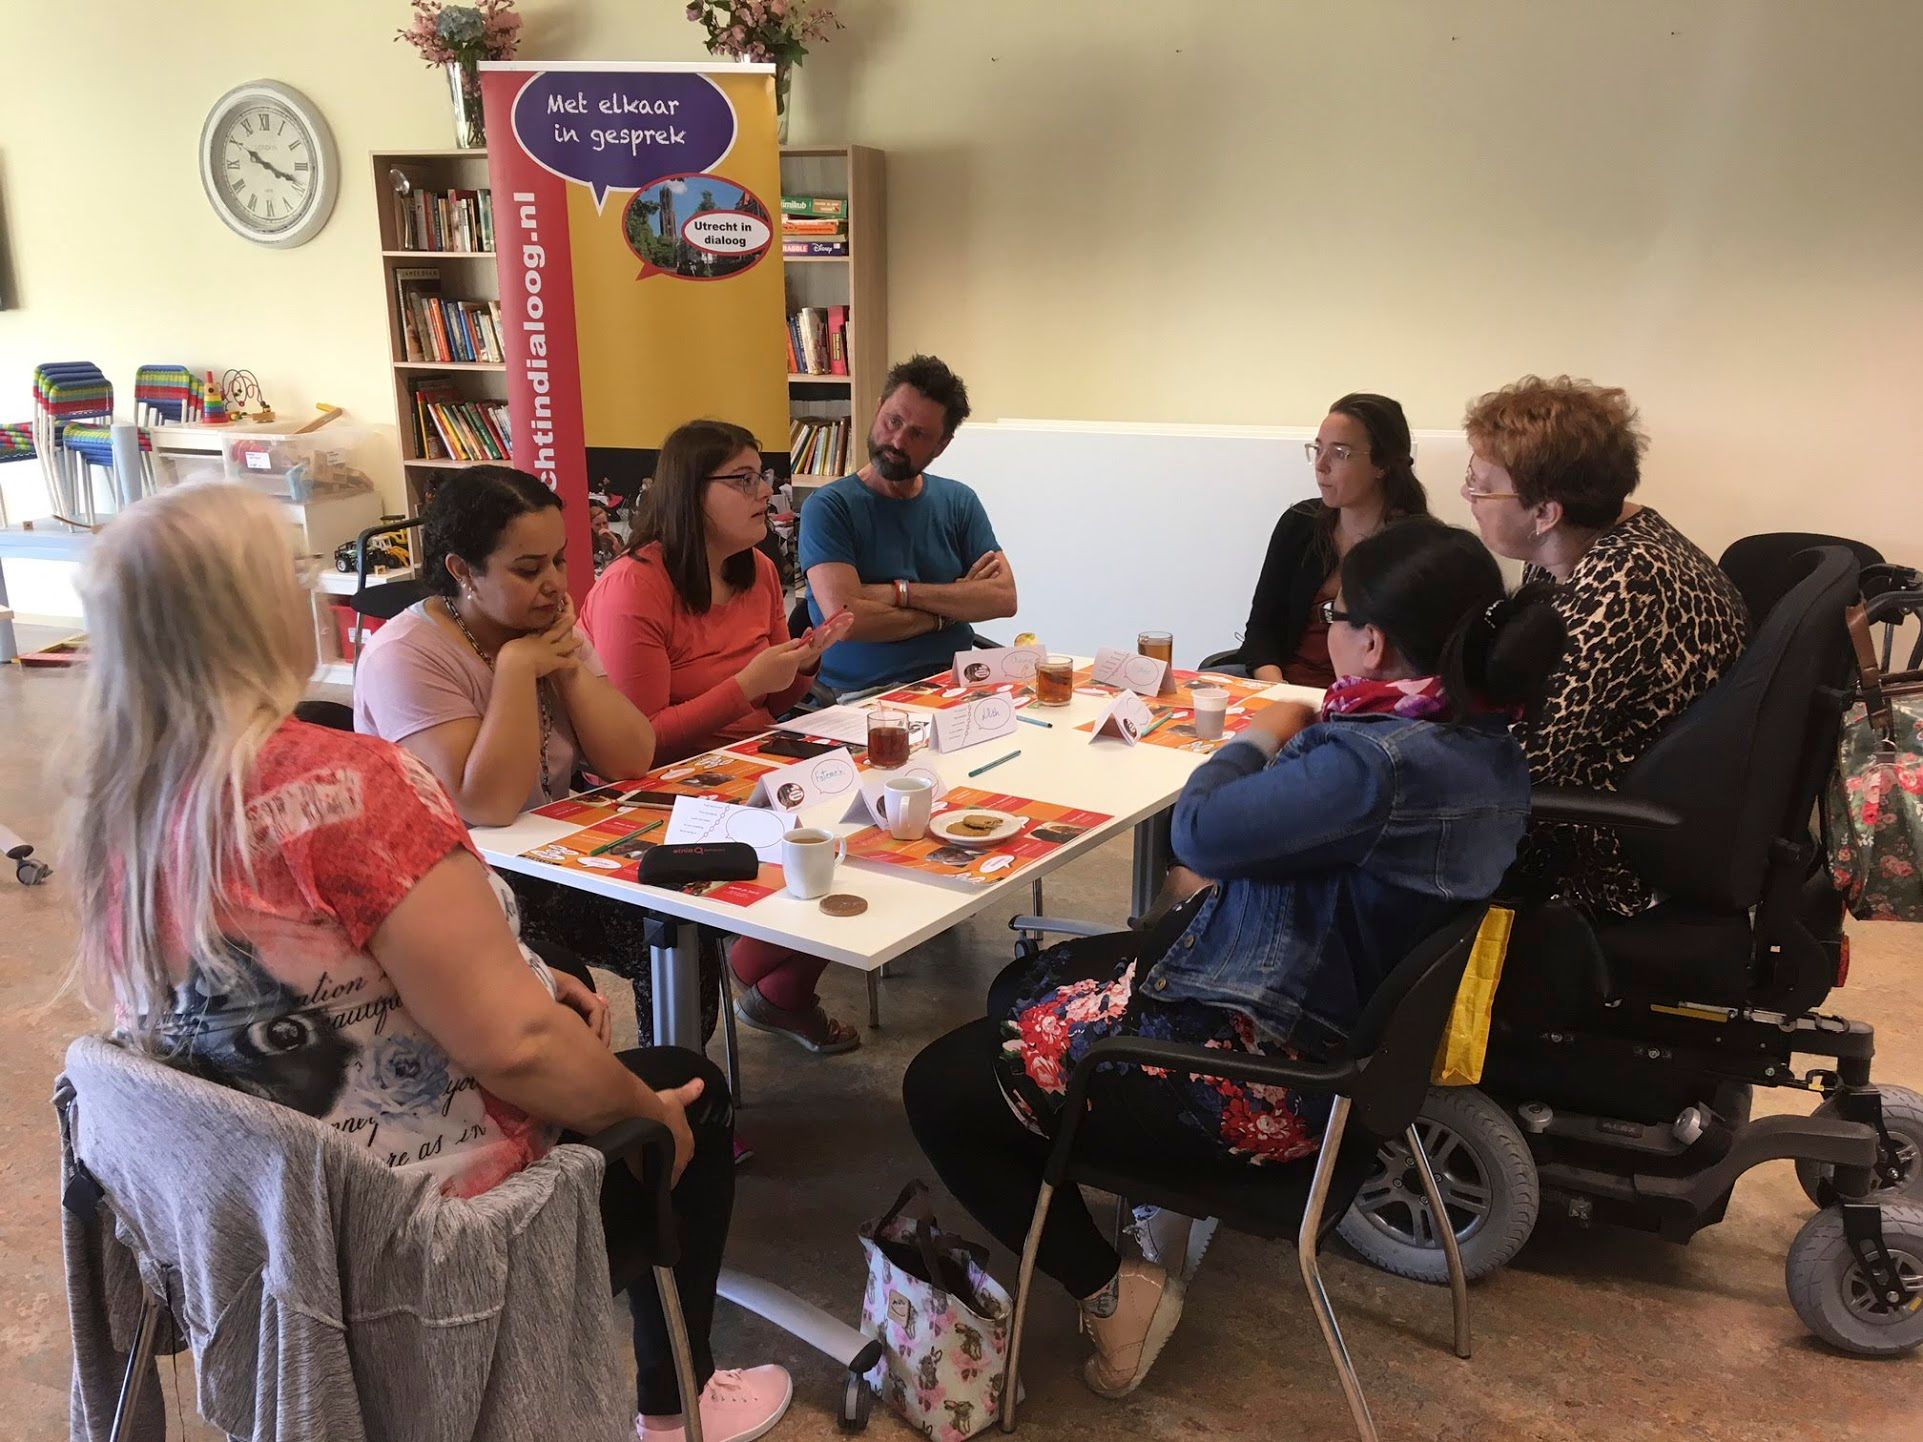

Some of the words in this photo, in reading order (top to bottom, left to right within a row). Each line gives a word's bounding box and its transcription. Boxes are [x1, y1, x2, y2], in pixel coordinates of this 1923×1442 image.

[547, 92, 588, 114] Met
[599, 93, 680, 115] elkaar
[258, 113, 270, 131] XII
[554, 123, 579, 143] in
[590, 125, 687, 156] gesprek
[294, 161, 309, 171] III
[694, 221, 738, 232] Utrecht
[740, 222, 752, 232] in
[704, 234, 747, 248] dialoog
[811, 243, 833, 254] Disney
[418, 1134, 443, 1160] as
